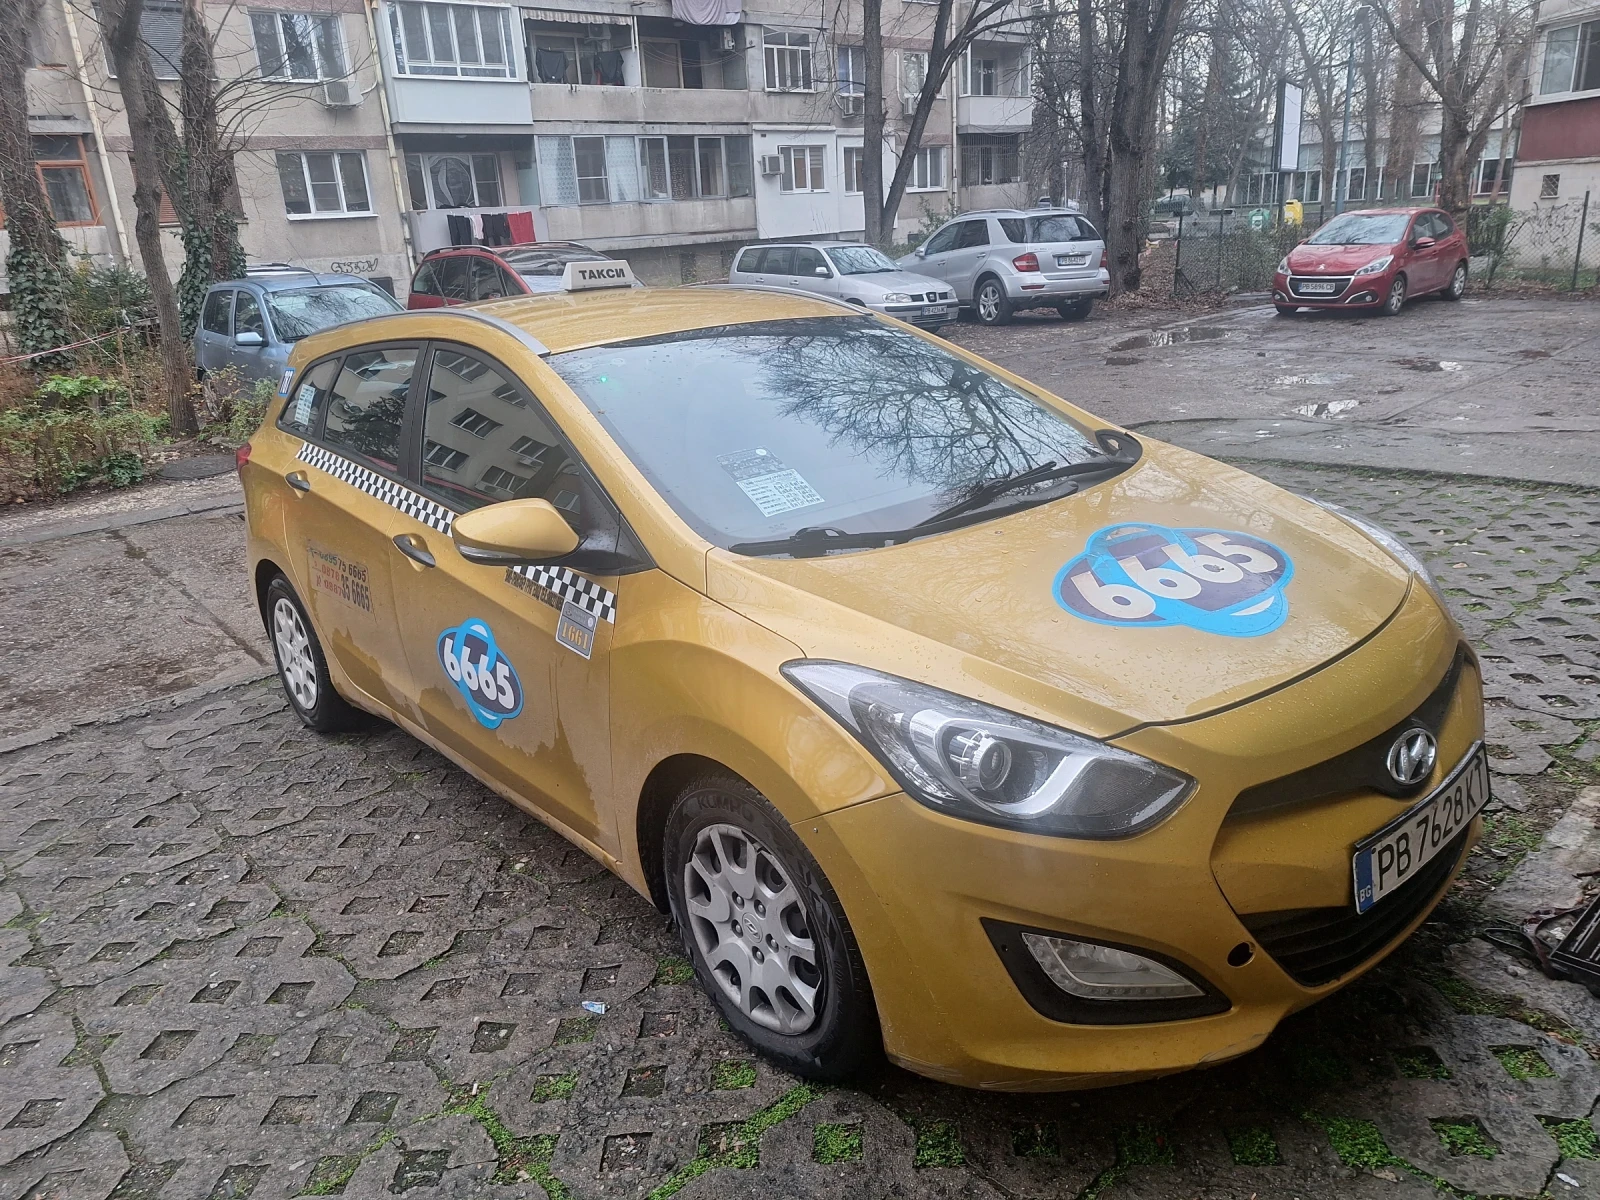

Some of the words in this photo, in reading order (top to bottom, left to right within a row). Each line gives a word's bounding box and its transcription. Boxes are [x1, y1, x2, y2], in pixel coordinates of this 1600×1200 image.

[578, 268, 625, 280] ТАКСИ
[1070, 533, 1278, 618] 6665
[561, 622, 589, 650] 1661
[443, 637, 515, 709] 6665
[1359, 884, 1373, 902] BG
